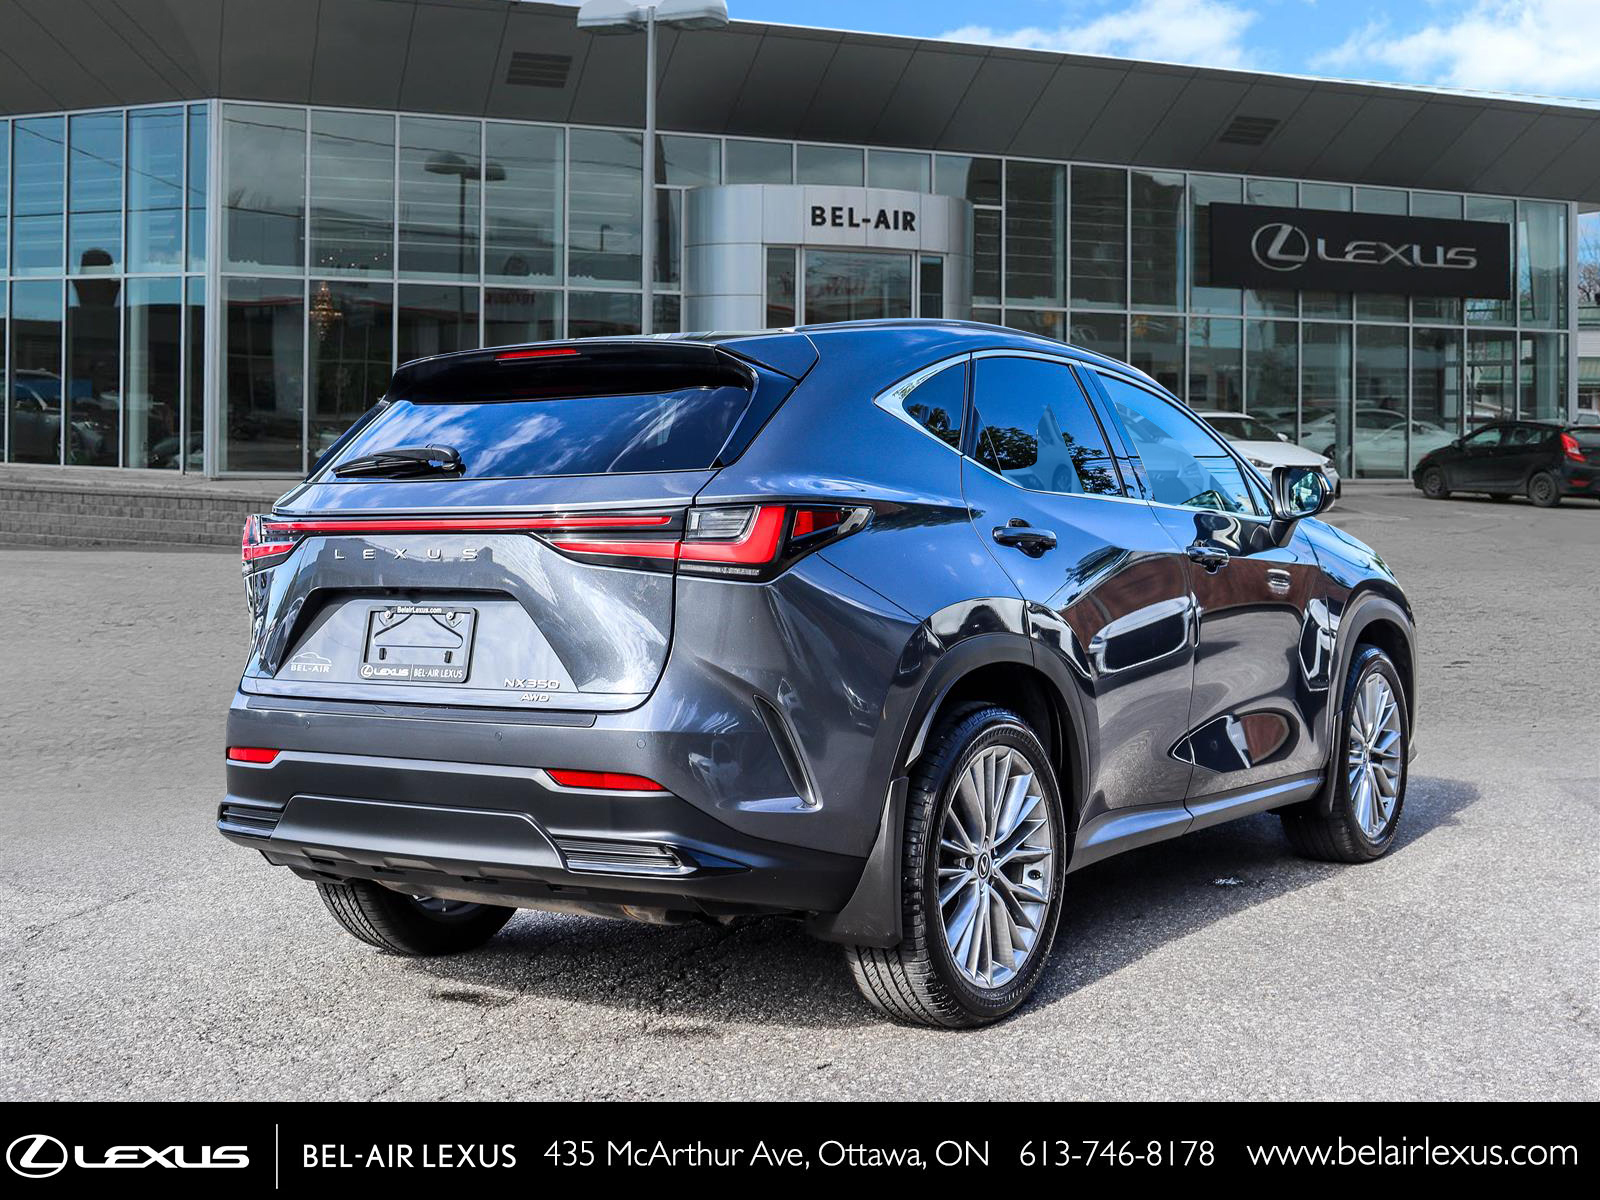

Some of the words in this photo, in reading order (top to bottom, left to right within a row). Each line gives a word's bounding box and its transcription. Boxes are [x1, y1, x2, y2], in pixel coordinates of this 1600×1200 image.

[811, 206, 916, 232] BEL-AIR
[1316, 237, 1478, 270] LEXUS
[334, 548, 478, 562] LEXUS
[290, 664, 331, 673] BEL-AIR
[374, 668, 409, 677] LEXUS
[413, 668, 440, 678] BEL-AIR
[441, 669, 463, 679] LEXUS
[503, 678, 560, 690] NX350
[520, 693, 550, 702] AWD
